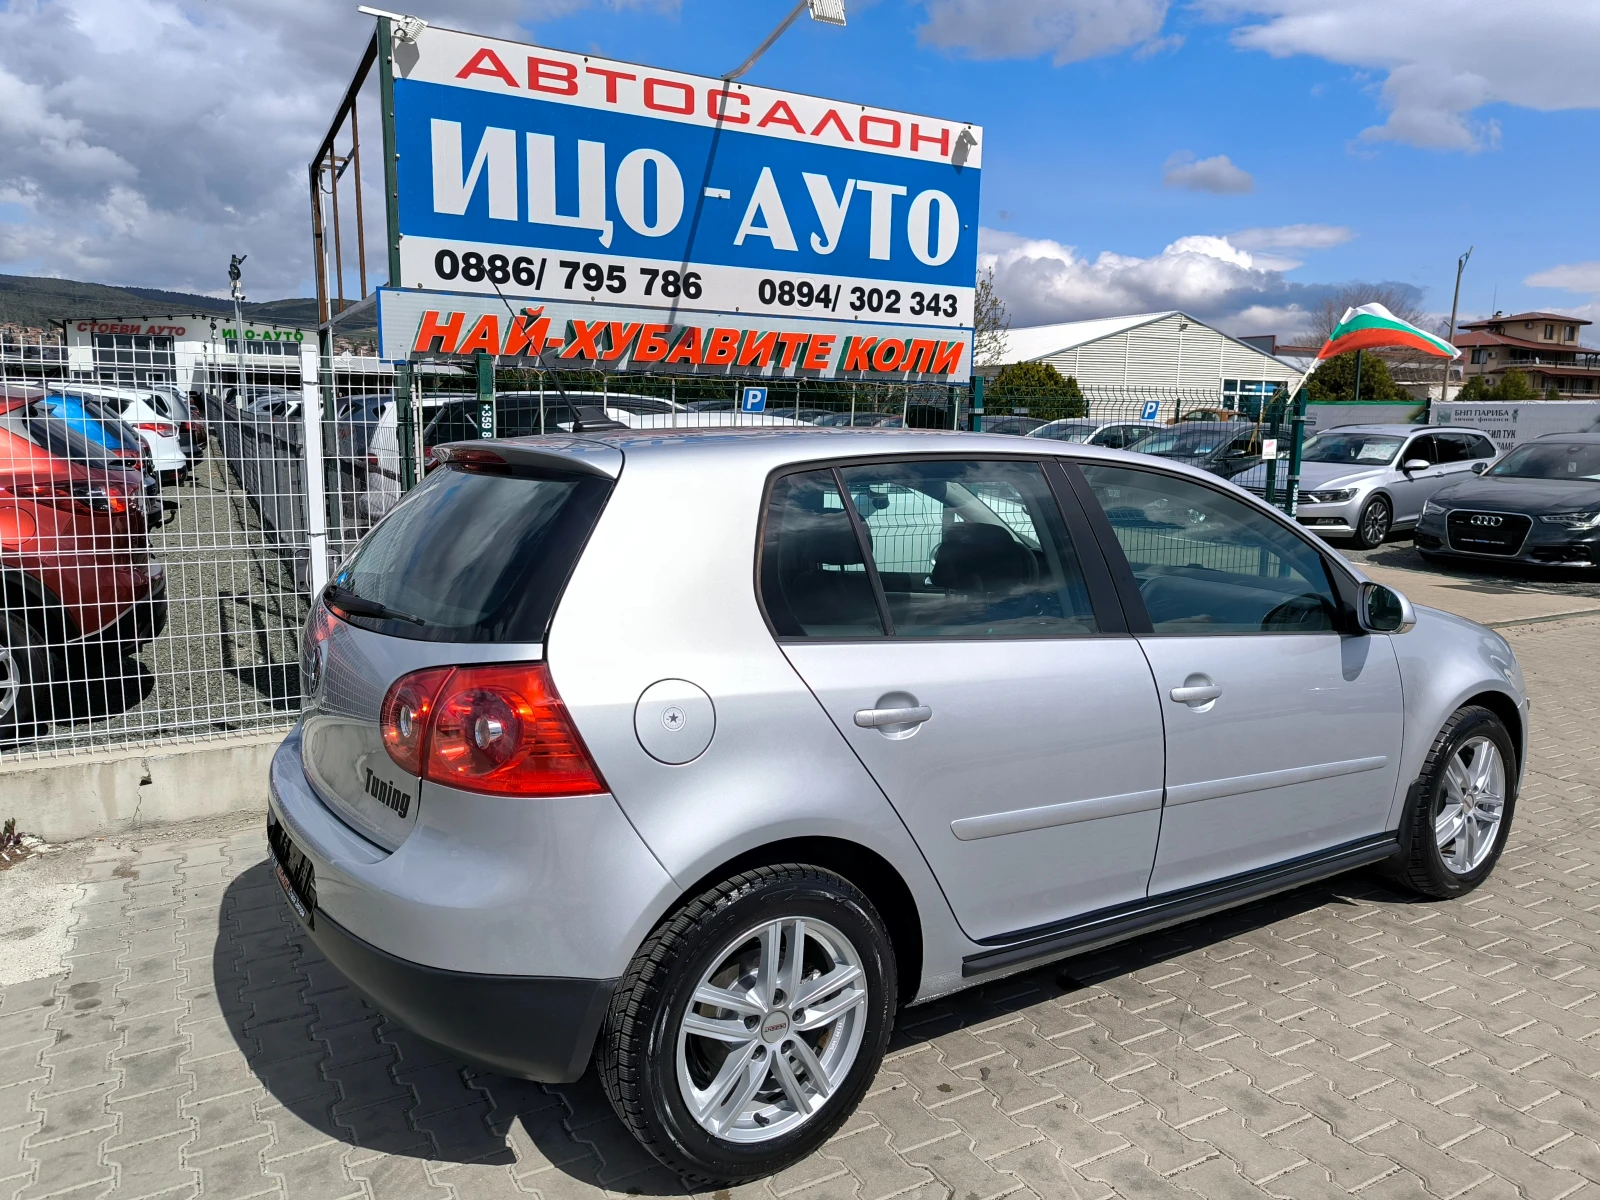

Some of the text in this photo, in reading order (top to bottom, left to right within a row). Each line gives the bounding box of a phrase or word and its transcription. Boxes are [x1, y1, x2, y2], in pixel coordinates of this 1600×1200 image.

[455, 47, 950, 157] АВТОСАЛОН
[434, 248, 703, 300] 0886/ 795 786
[758, 278, 958, 318] 0894/ 302 343
[77, 322, 187, 337] СТОЕВИ АУТО
[411, 305, 966, 375] НАЙ-ХУБАВИТЕ КОЛИ
[481, 404, 491, 428] +359
[747, 390, 761, 409] P
[1454, 409, 1508, 417] БНП ПАРИБА
[365, 767, 412, 819] Tuning
